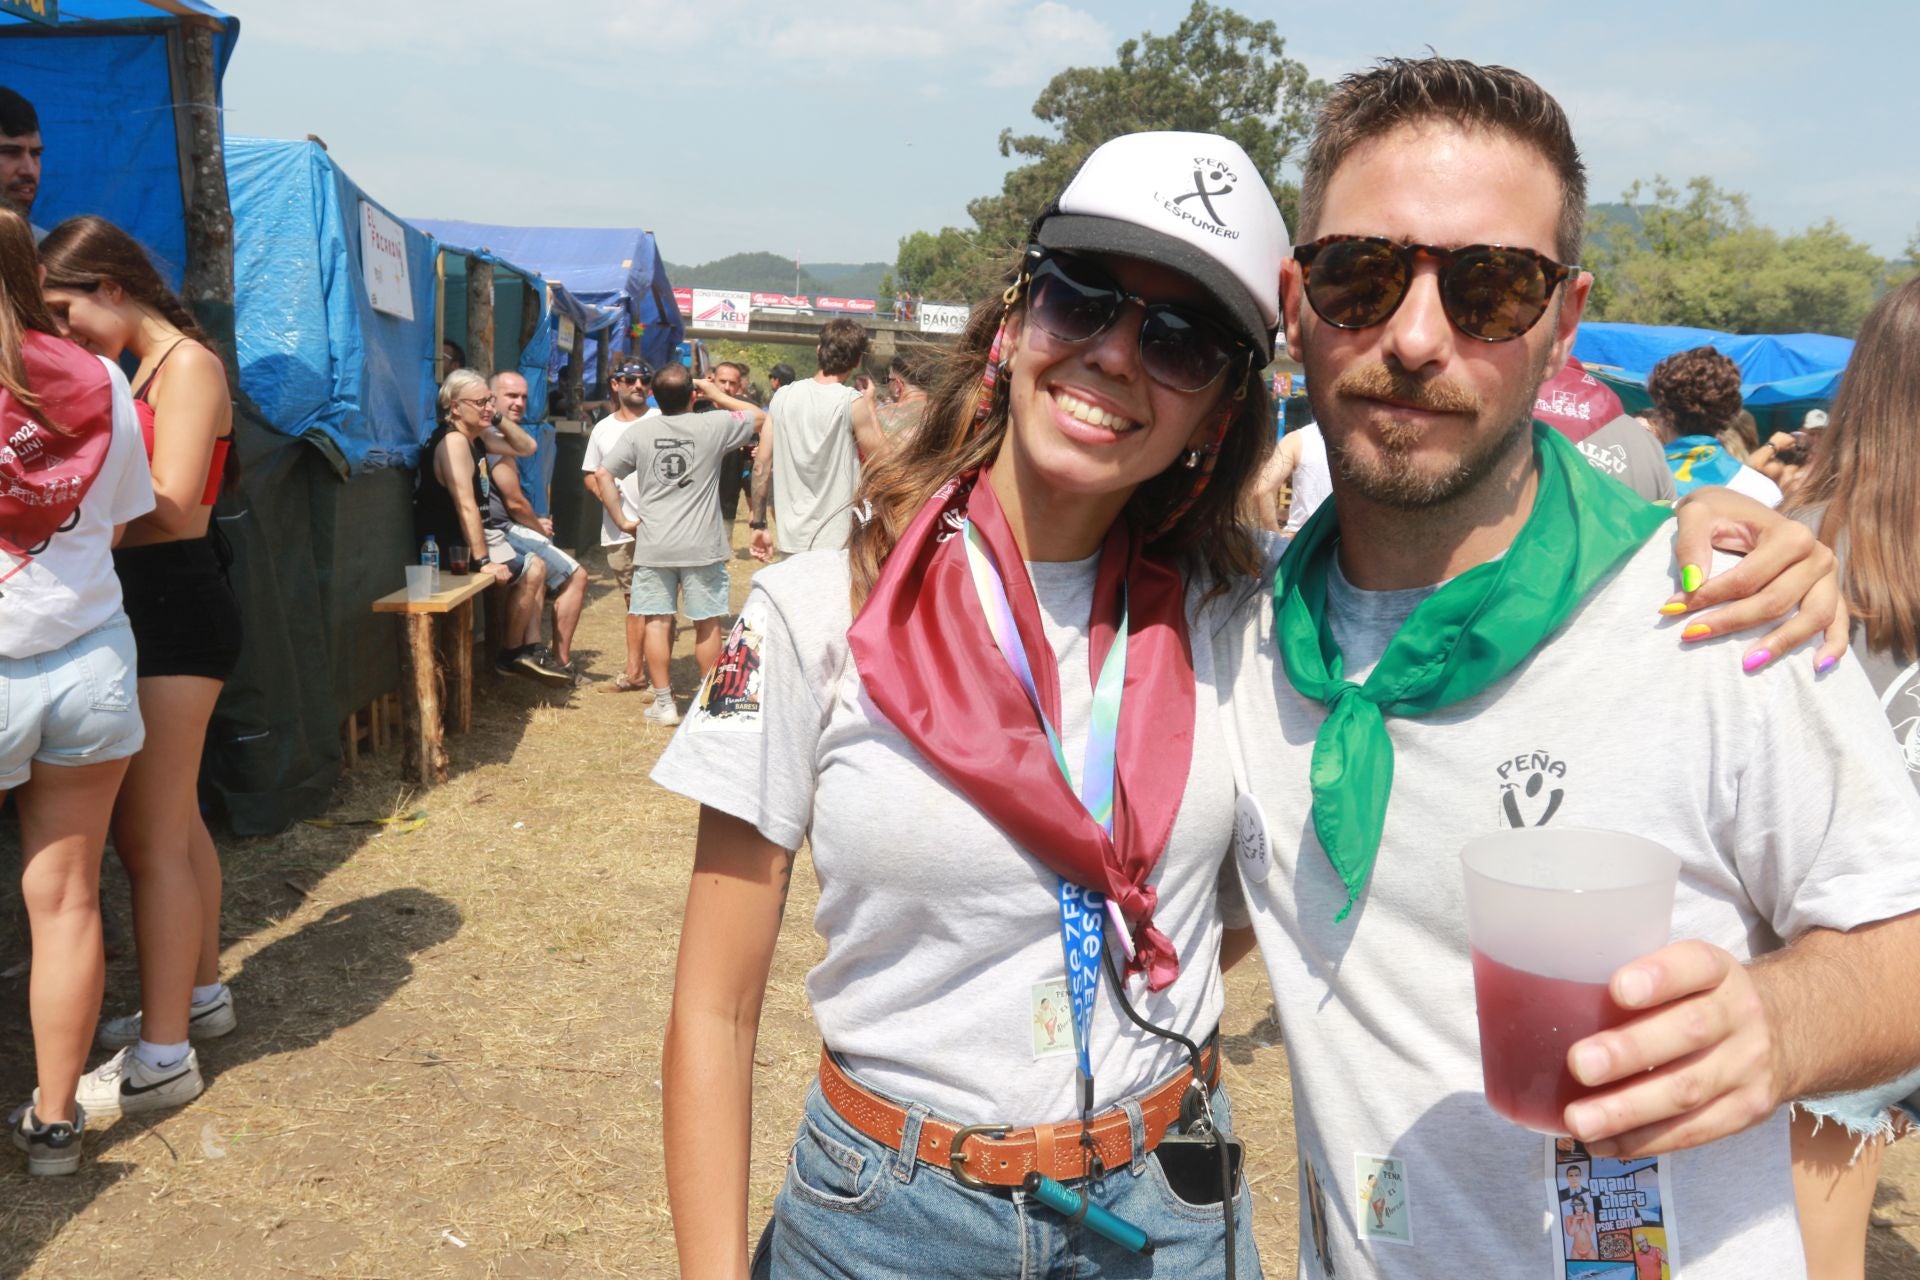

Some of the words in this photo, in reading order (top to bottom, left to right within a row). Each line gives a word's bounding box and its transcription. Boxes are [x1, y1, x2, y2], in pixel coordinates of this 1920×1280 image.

[721, 312, 748, 323] KELY
[923, 312, 967, 327] BAÑOS
[9, 420, 39, 448] 2025
[1496, 749, 1567, 780] PEÑA
[1600, 1190, 1646, 1209] theft
[1598, 1206, 1636, 1222] auto
[1596, 1220, 1615, 1232] PSOE
